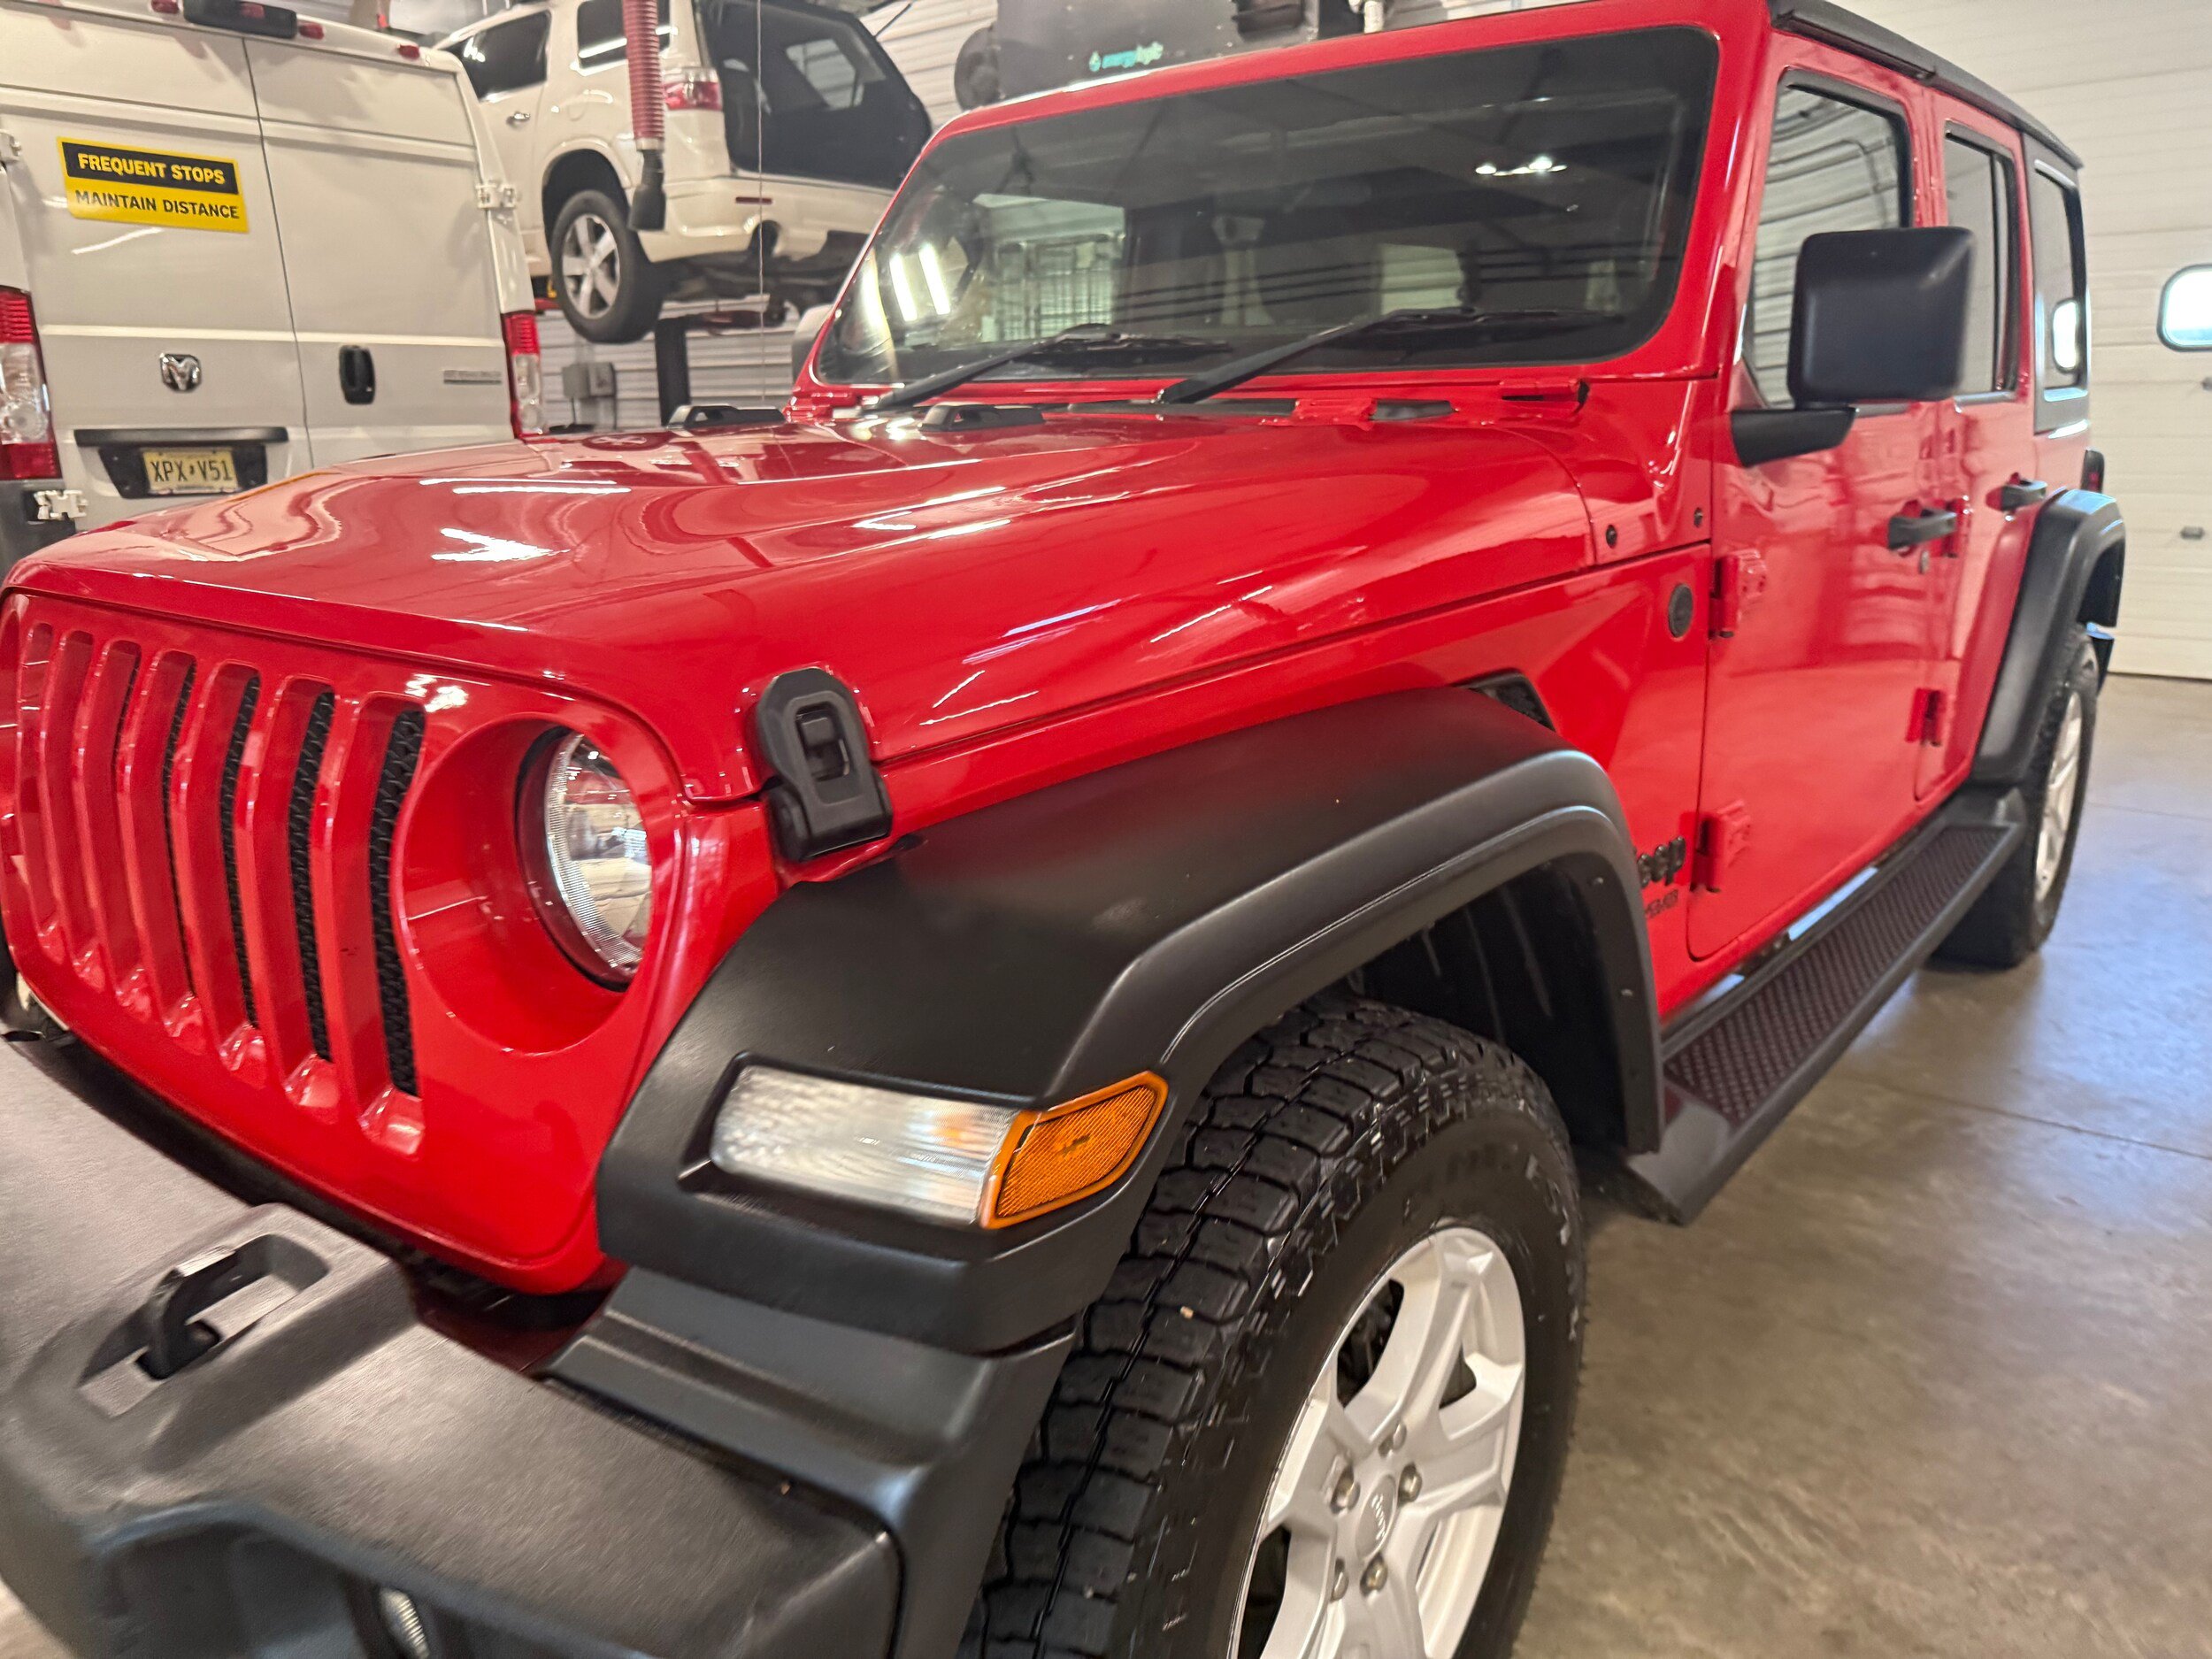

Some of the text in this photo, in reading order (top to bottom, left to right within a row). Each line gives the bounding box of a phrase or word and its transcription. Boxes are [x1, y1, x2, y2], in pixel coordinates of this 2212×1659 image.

[77, 153, 226, 185] FREQUENT STOPS
[75, 189, 240, 219] MAINTAIN DISTANCE
[1633, 835, 1686, 889] eep
